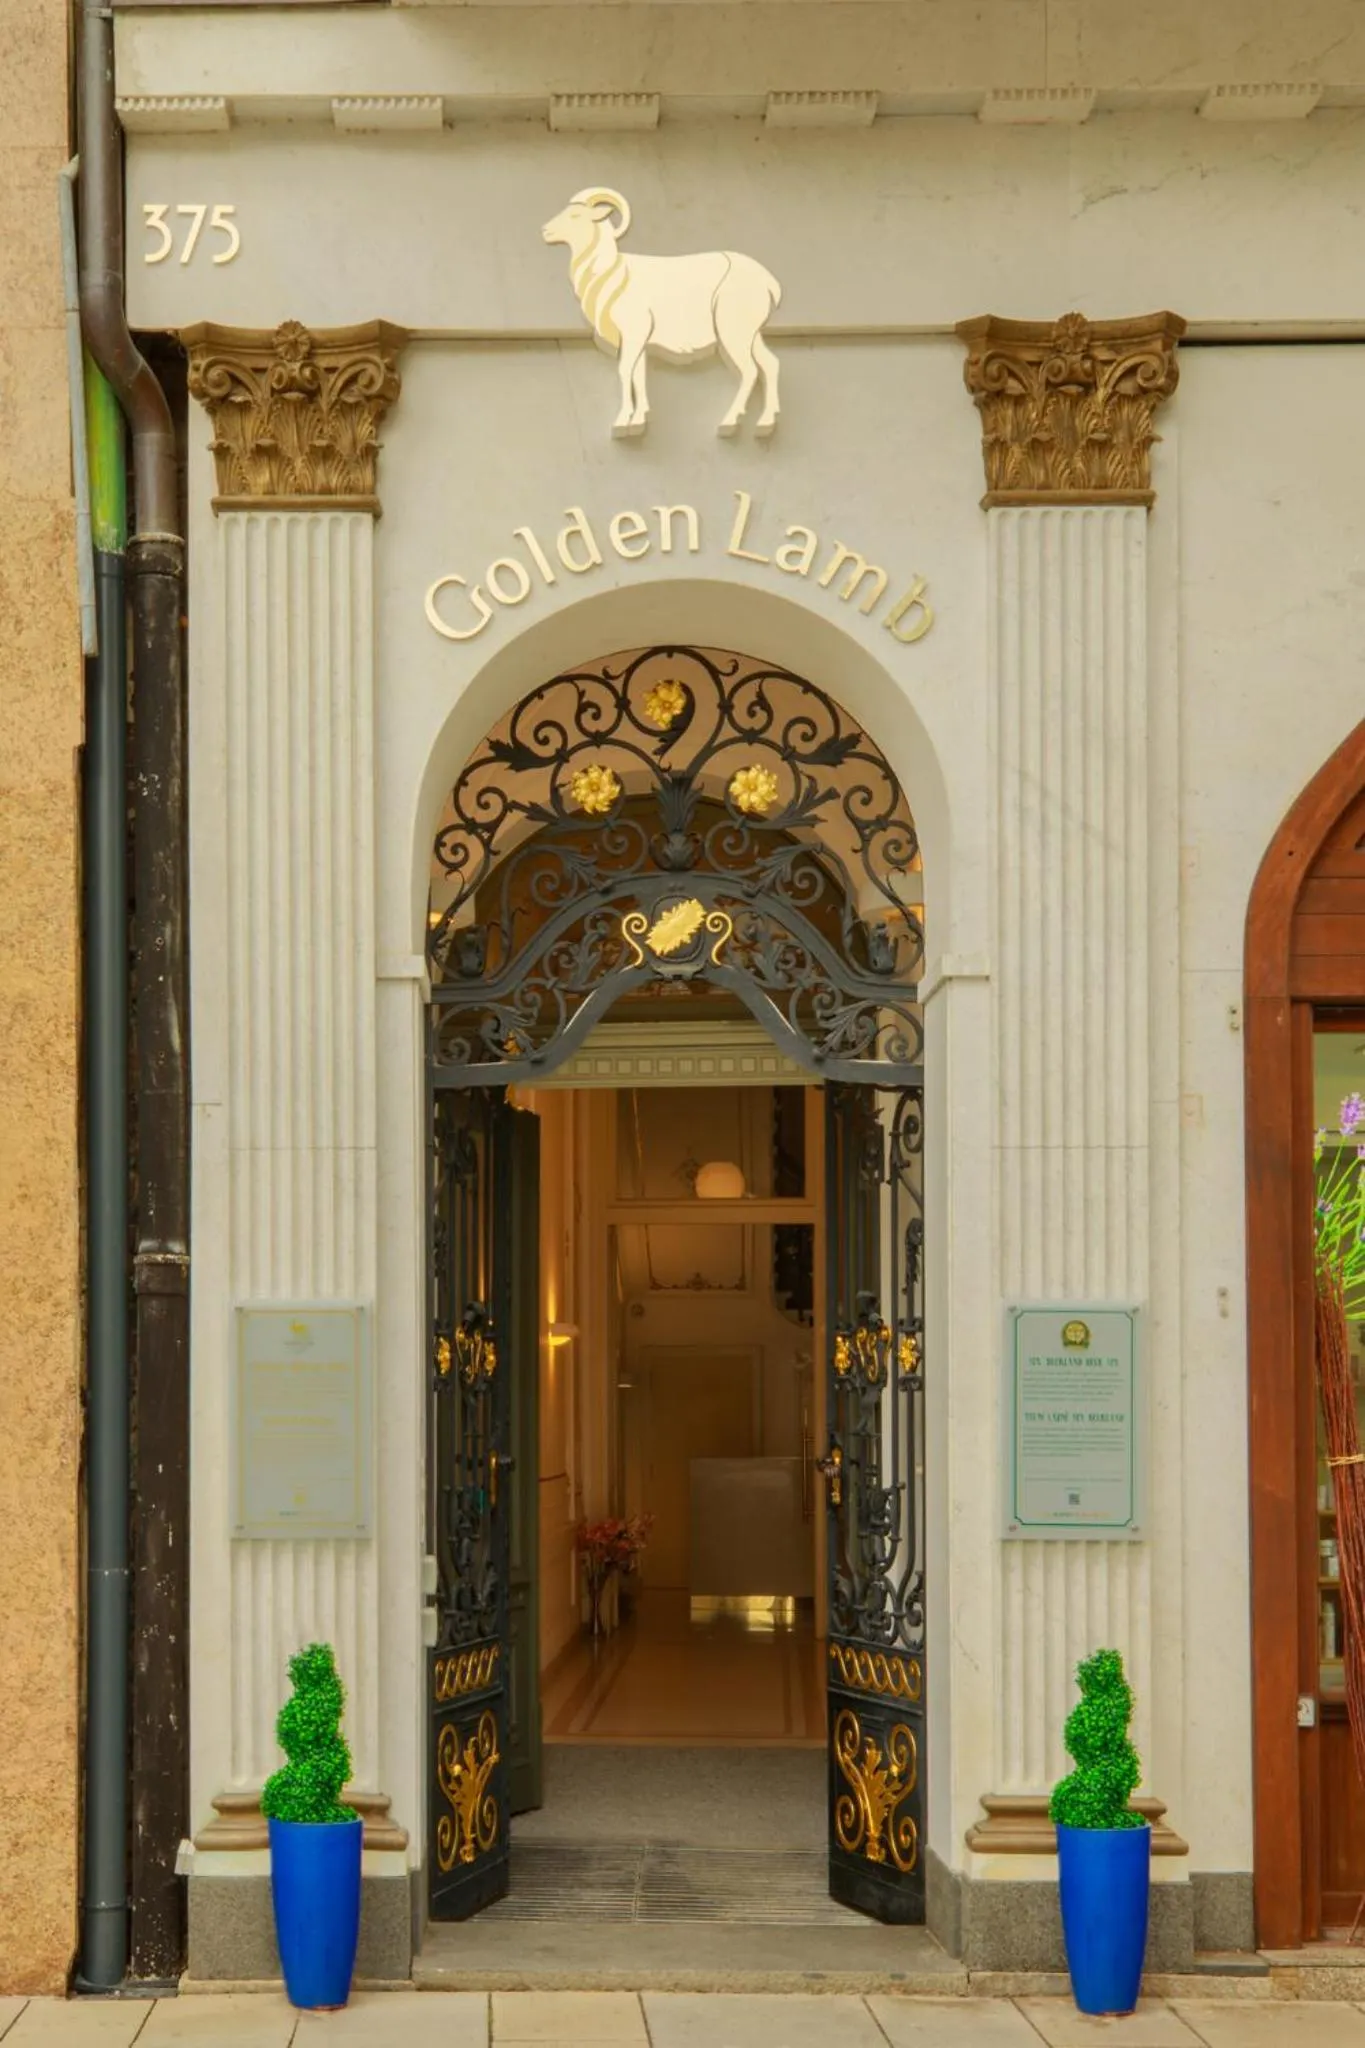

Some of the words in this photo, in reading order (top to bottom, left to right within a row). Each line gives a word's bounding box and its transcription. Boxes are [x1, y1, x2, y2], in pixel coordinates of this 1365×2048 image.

[143, 204, 240, 263] 375
[424, 504, 700, 640] Golden
[726, 490, 935, 643] Lamb
